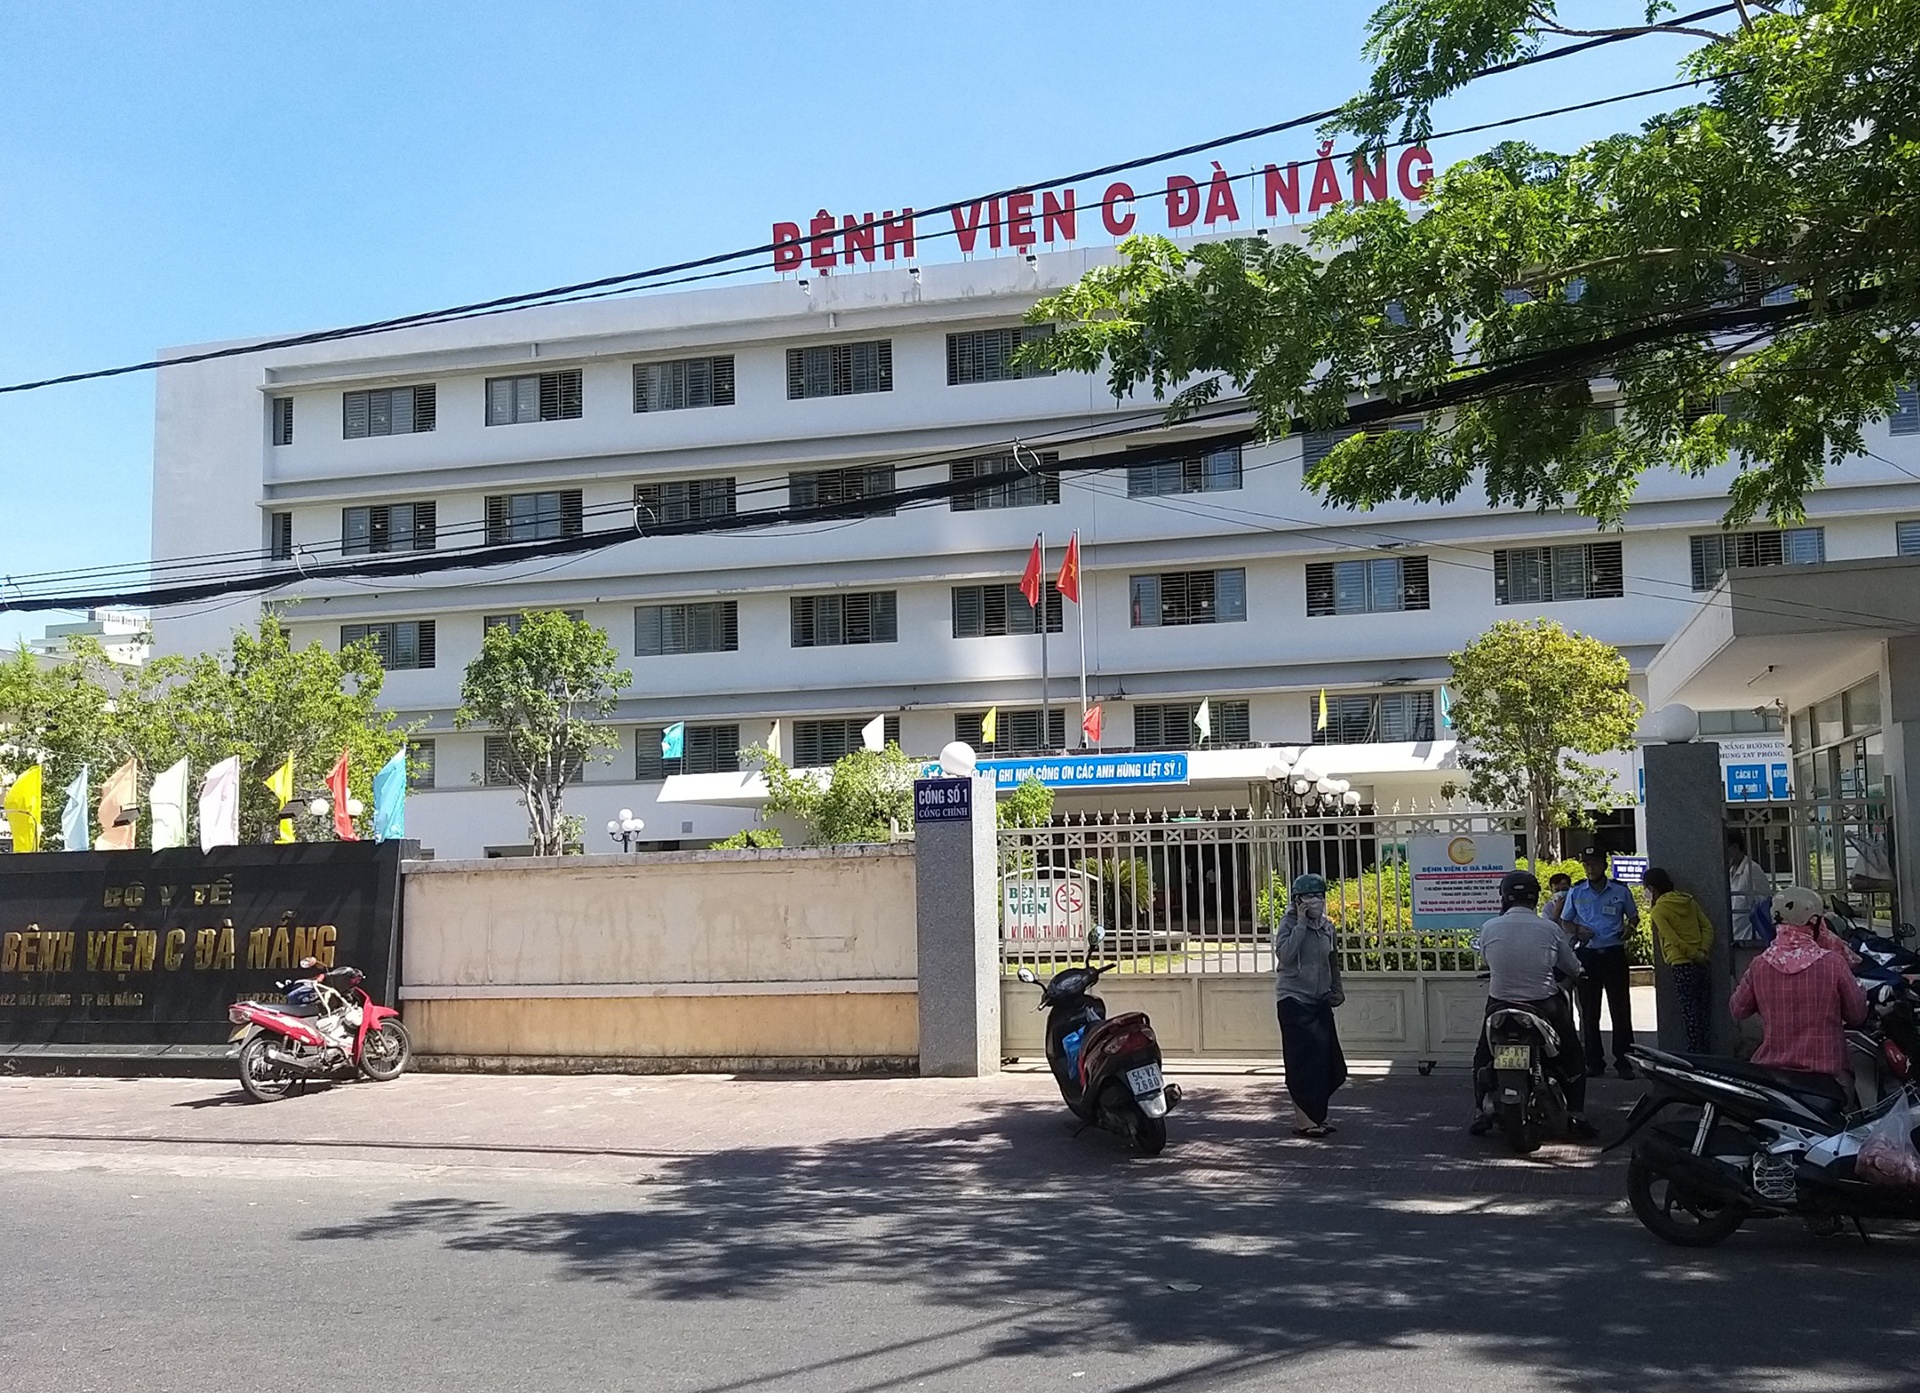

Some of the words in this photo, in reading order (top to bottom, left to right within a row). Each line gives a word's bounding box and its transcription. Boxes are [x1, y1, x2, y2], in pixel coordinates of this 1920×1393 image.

[773, 208, 916, 276] BỆNH
[950, 187, 1077, 253] VIỆN
[1102, 182, 1136, 236] C
[1165, 161, 1240, 228] ĐÀ
[1264, 140, 1434, 217] NẴNG
[1720, 751, 1741, 759] HUNG
[999, 768, 1014, 782] GHI
[1036, 764, 1060, 780] CÔNG
[1061, 765, 1074, 780] ƠN
[1076, 763, 1095, 779] CÁC
[1096, 764, 1115, 778] ANH
[1116, 762, 1141, 778] HÙNG
[1143, 760, 1161, 779] LIỆT
[1164, 760, 1175, 776] SỸ
[919, 784, 945, 805] CỔNG
[947, 783, 961, 804] SỐ
[962, 788, 968, 803] 1
[942, 805, 968, 817] CHÍNH
[104, 881, 146, 912] BỘ
[160, 885, 179, 906] Y
[191, 873, 233, 906] TẾ
[1, 923, 76, 981] BỆNH
[86, 922, 158, 981] VIỆN
[165, 928, 186, 971] C
[194, 917, 235, 970] ĐÀ
[247, 909, 337, 970] NẴNG
